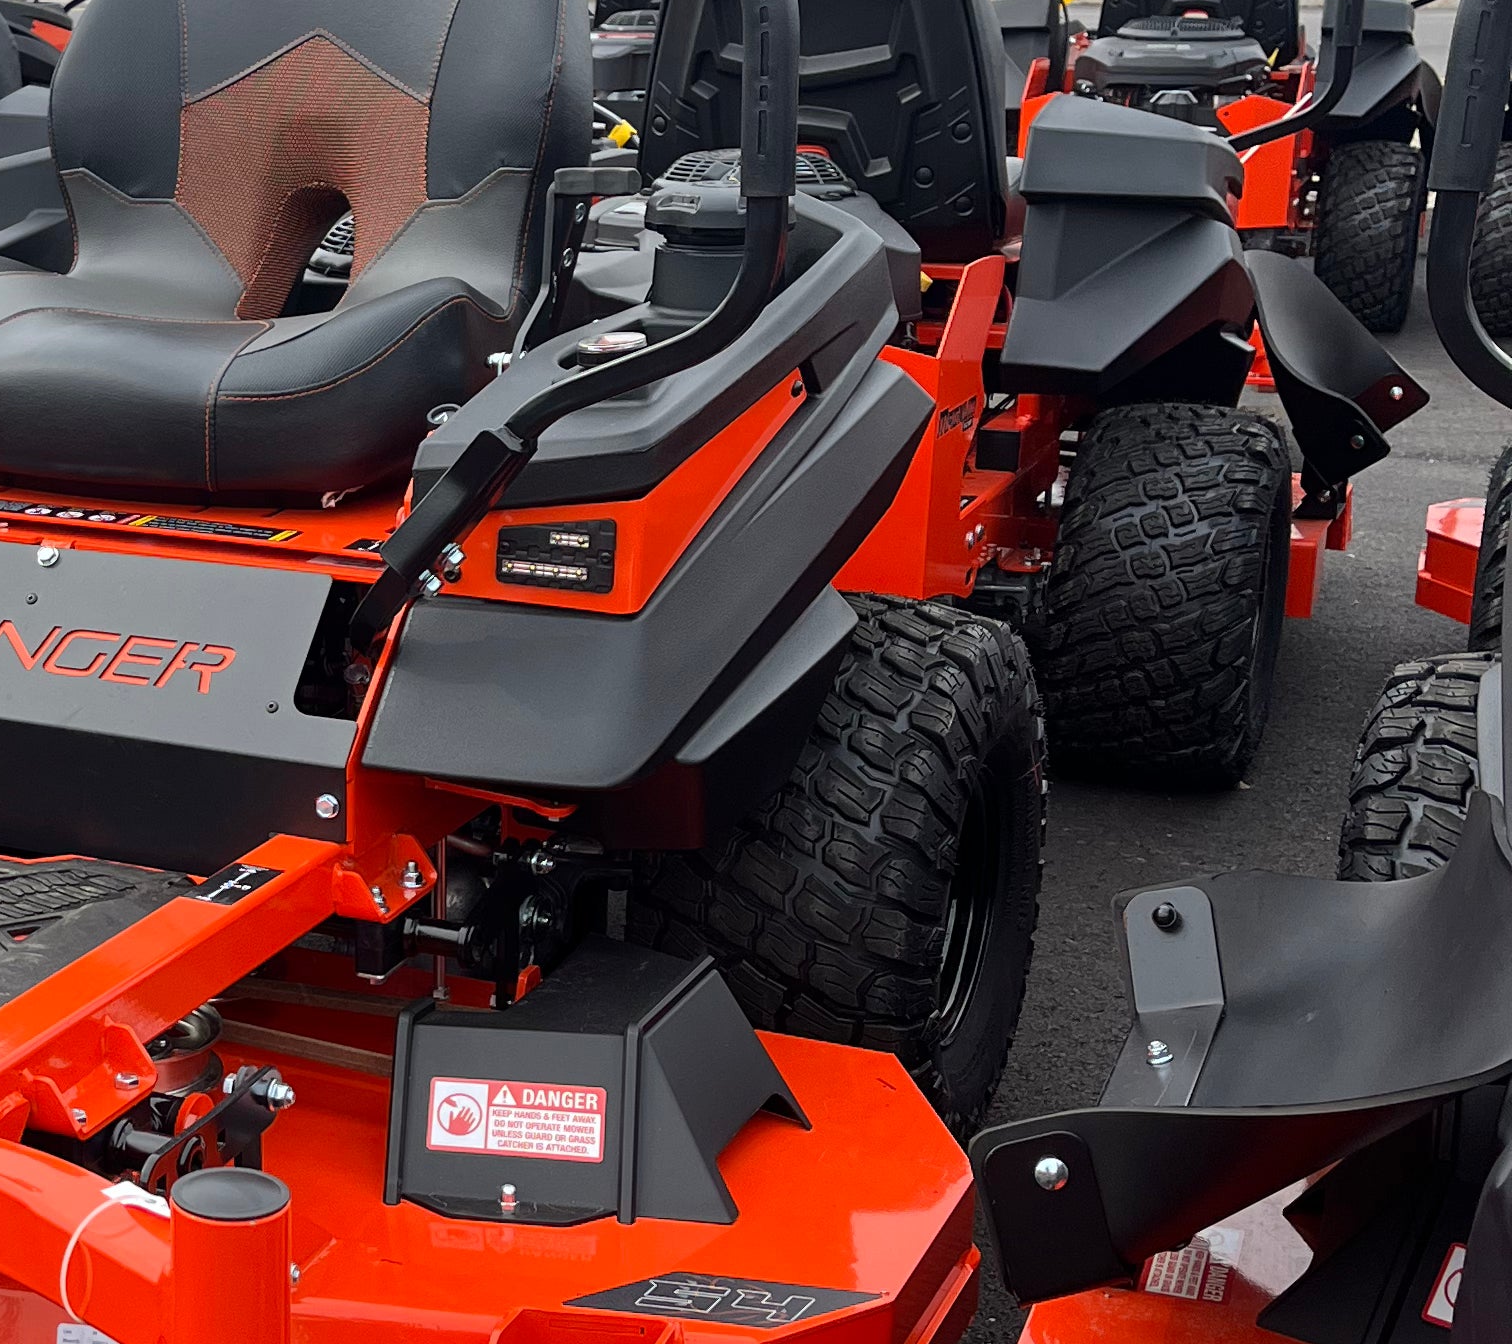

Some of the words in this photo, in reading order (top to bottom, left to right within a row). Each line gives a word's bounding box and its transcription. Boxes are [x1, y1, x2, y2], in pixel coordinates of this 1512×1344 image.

[522, 1088, 599, 1110] DANGER
[492, 1108, 512, 1118] KEEP
[514, 1110, 542, 1120] HANDS
[543, 1112, 549, 1121] &
[551, 1113, 570, 1122] FEET
[494, 1119, 505, 1127] DO
[507, 1120, 524, 1129] NOT
[525, 1122, 560, 1132] OPERATE
[563, 1124, 594, 1134] MOWER
[492, 1129, 523, 1139] UNLESS
[525, 1131, 552, 1141] GUARD
[554, 1133, 566, 1142] OR
[568, 1135, 596, 1145] GRASS
[497, 1140, 534, 1150] CATCHER
[535, 1142, 543, 1150] IS
[634, 1279, 816, 1323] 54
